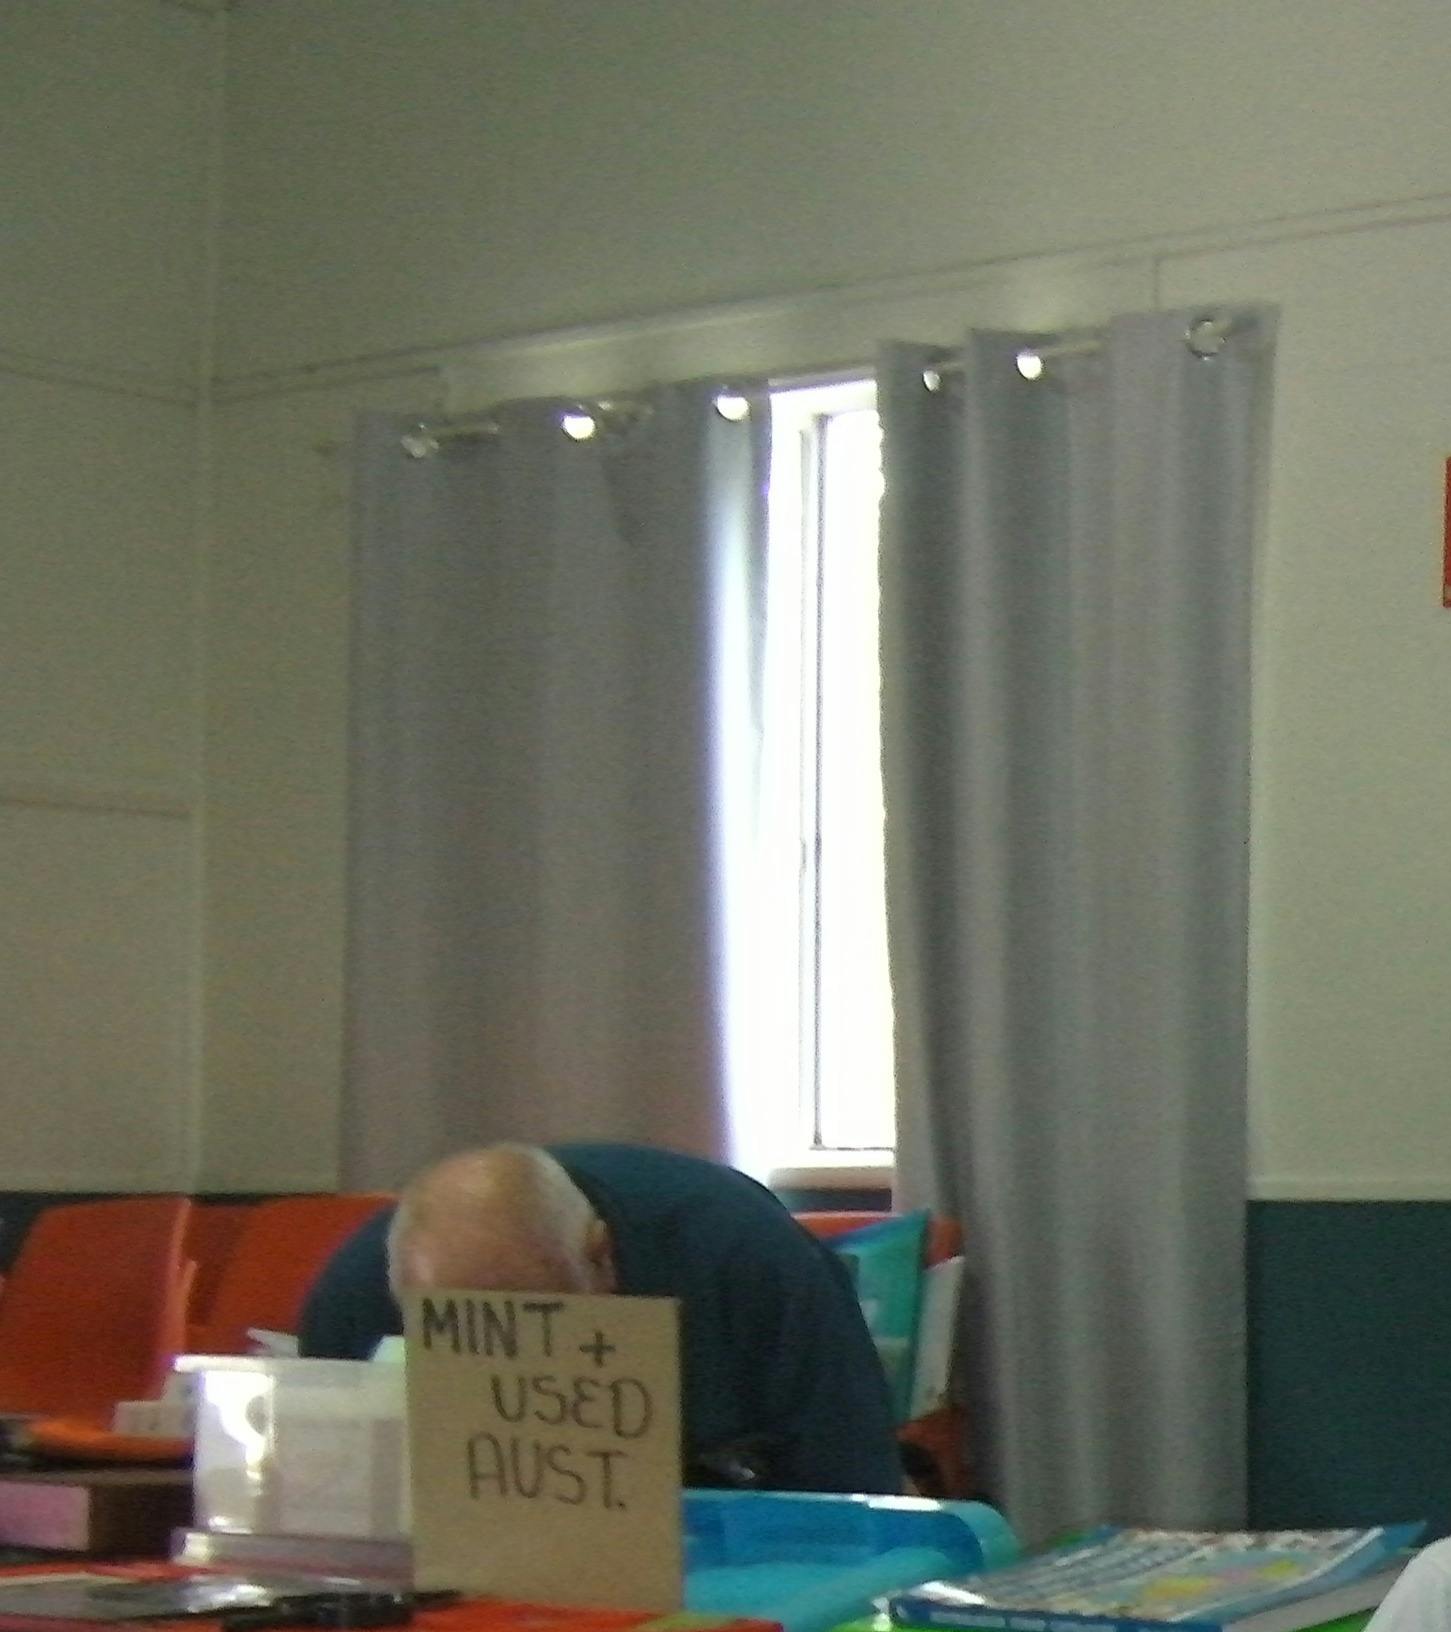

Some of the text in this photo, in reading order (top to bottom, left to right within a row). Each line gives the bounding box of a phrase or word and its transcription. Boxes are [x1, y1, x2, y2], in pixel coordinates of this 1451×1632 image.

[421, 1298, 616, 1367] MINT +
[489, 1374, 653, 1439] USED
